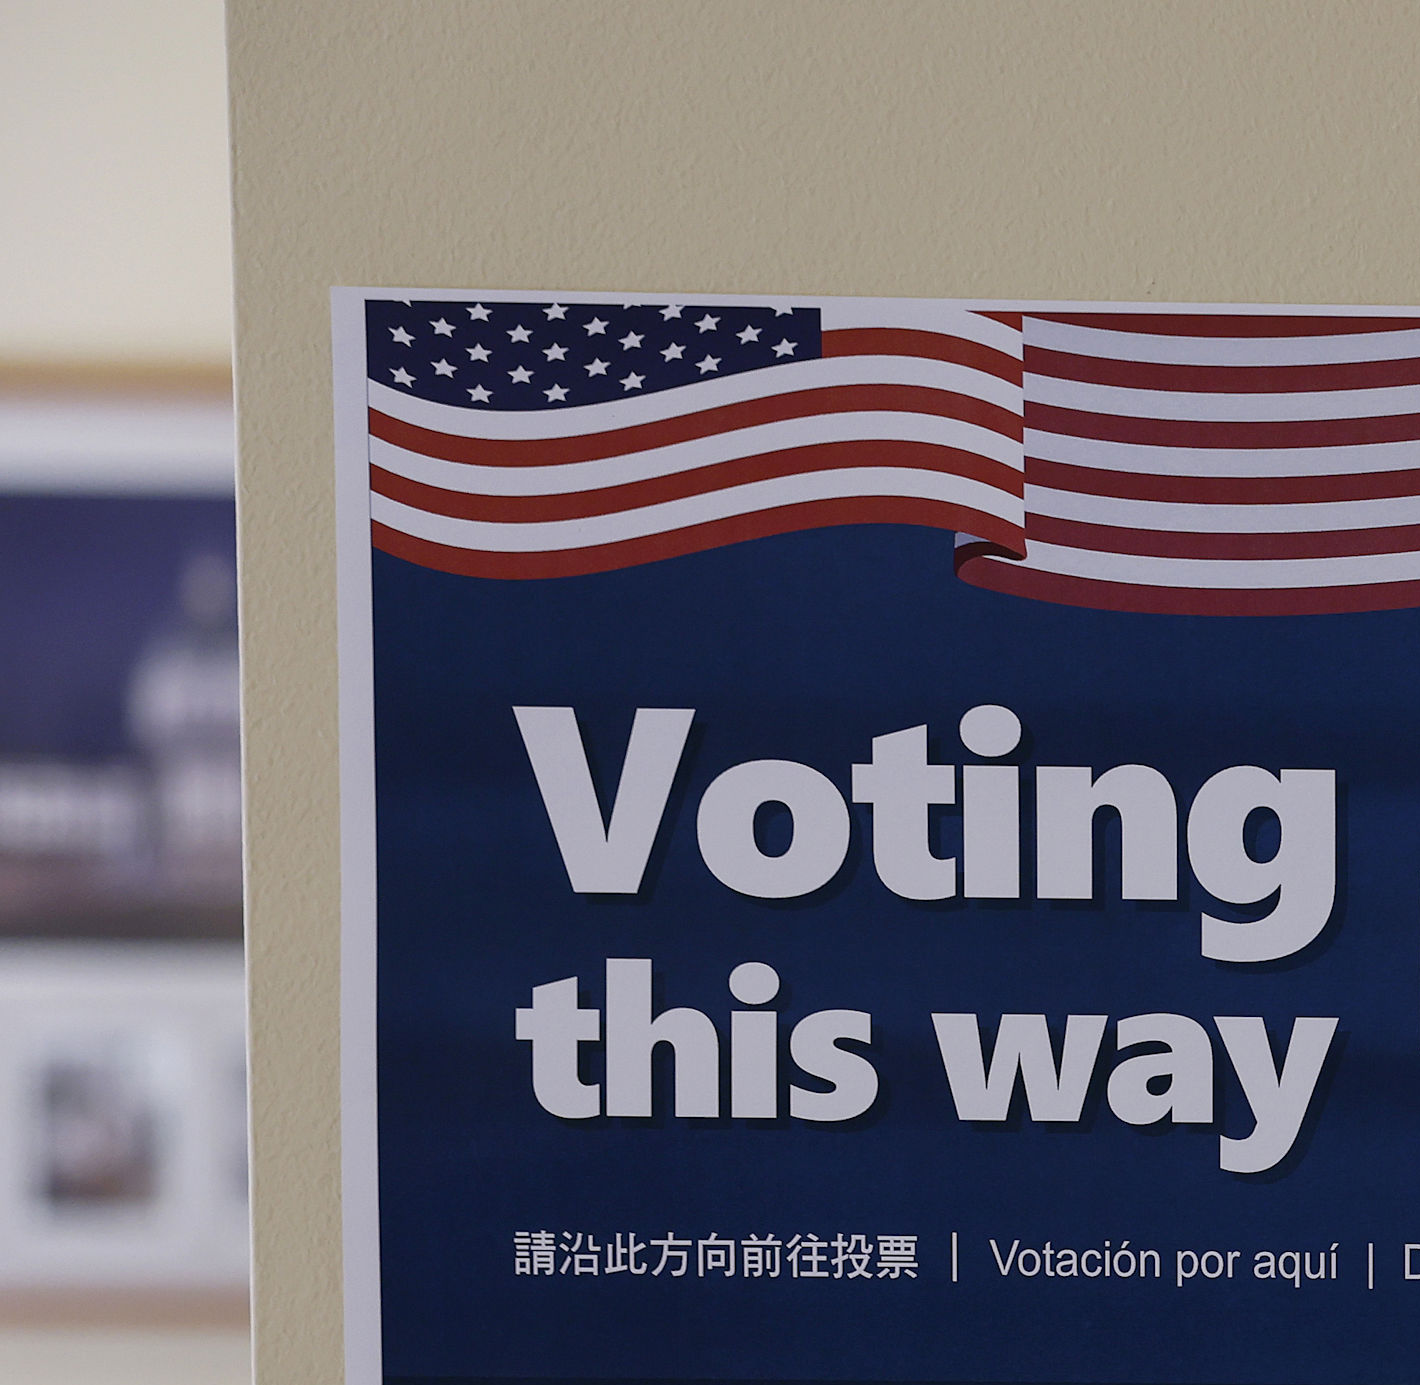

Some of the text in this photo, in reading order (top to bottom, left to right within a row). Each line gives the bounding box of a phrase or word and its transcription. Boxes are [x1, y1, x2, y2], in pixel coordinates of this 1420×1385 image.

[512, 704, 1336, 962] Voting
[515, 958, 1340, 1174] this way
[513, 1229, 919, 1279] 請沿此方向前往投票
[988, 1239, 1340, 1289] Votación por aquí
